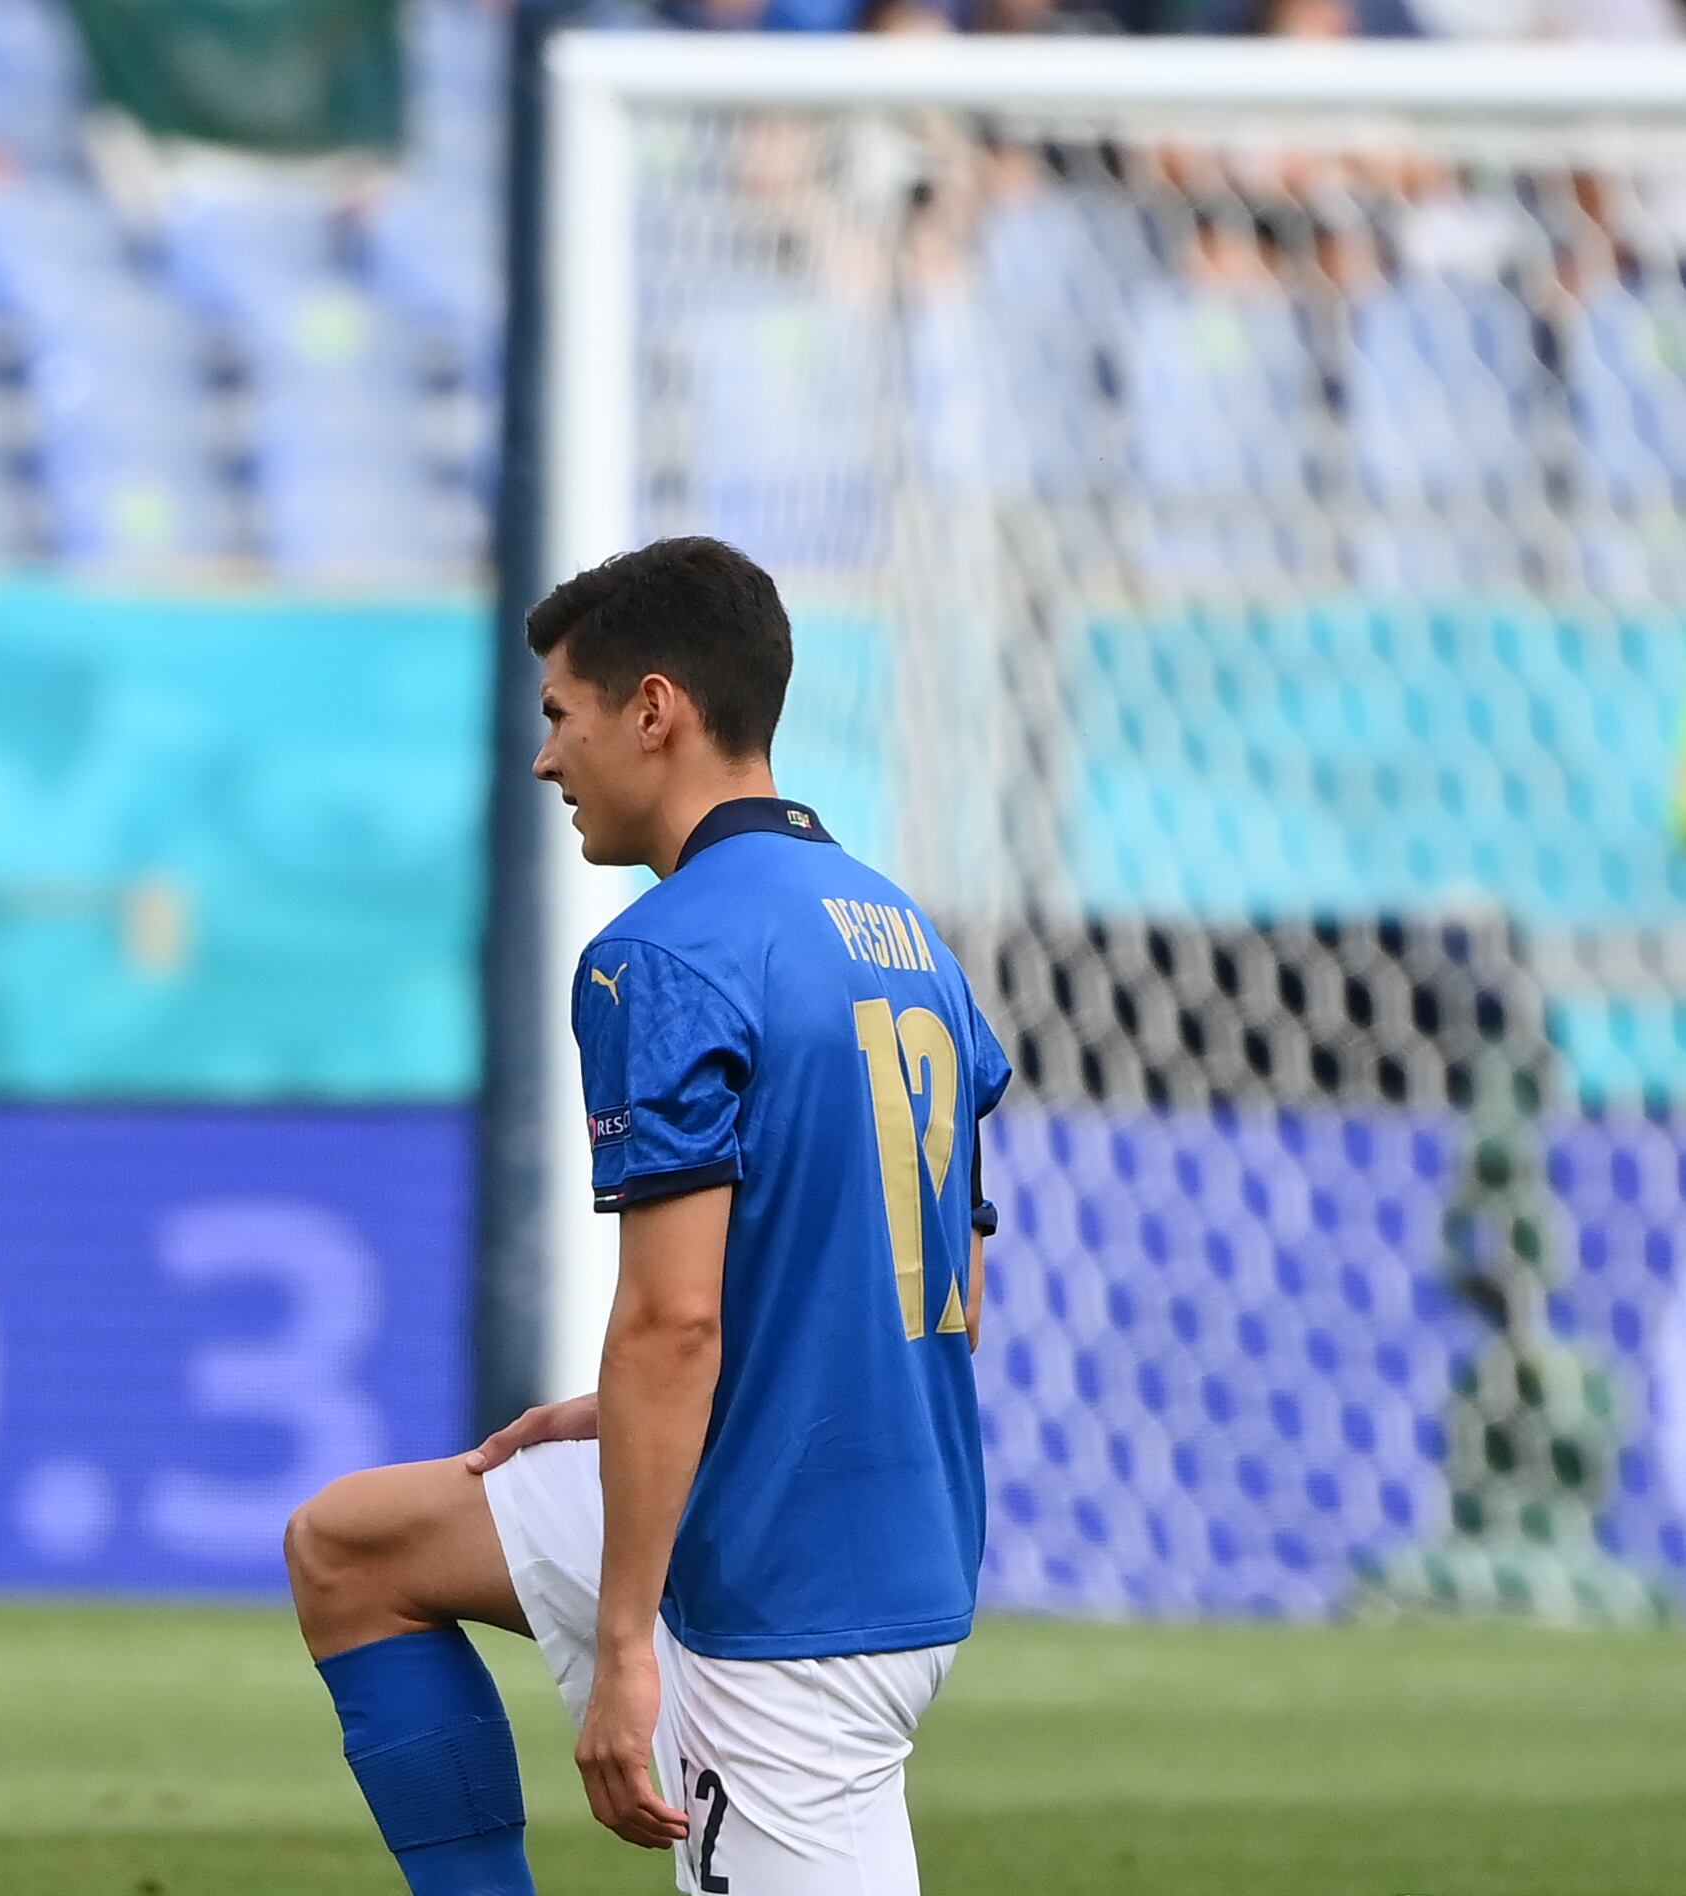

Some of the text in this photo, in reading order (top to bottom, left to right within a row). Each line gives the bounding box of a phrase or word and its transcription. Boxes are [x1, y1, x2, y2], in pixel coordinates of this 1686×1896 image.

[821, 898, 936, 972] PESSINA
[853, 997, 966, 1340] 12
[680, 1757, 729, 1894] 2
